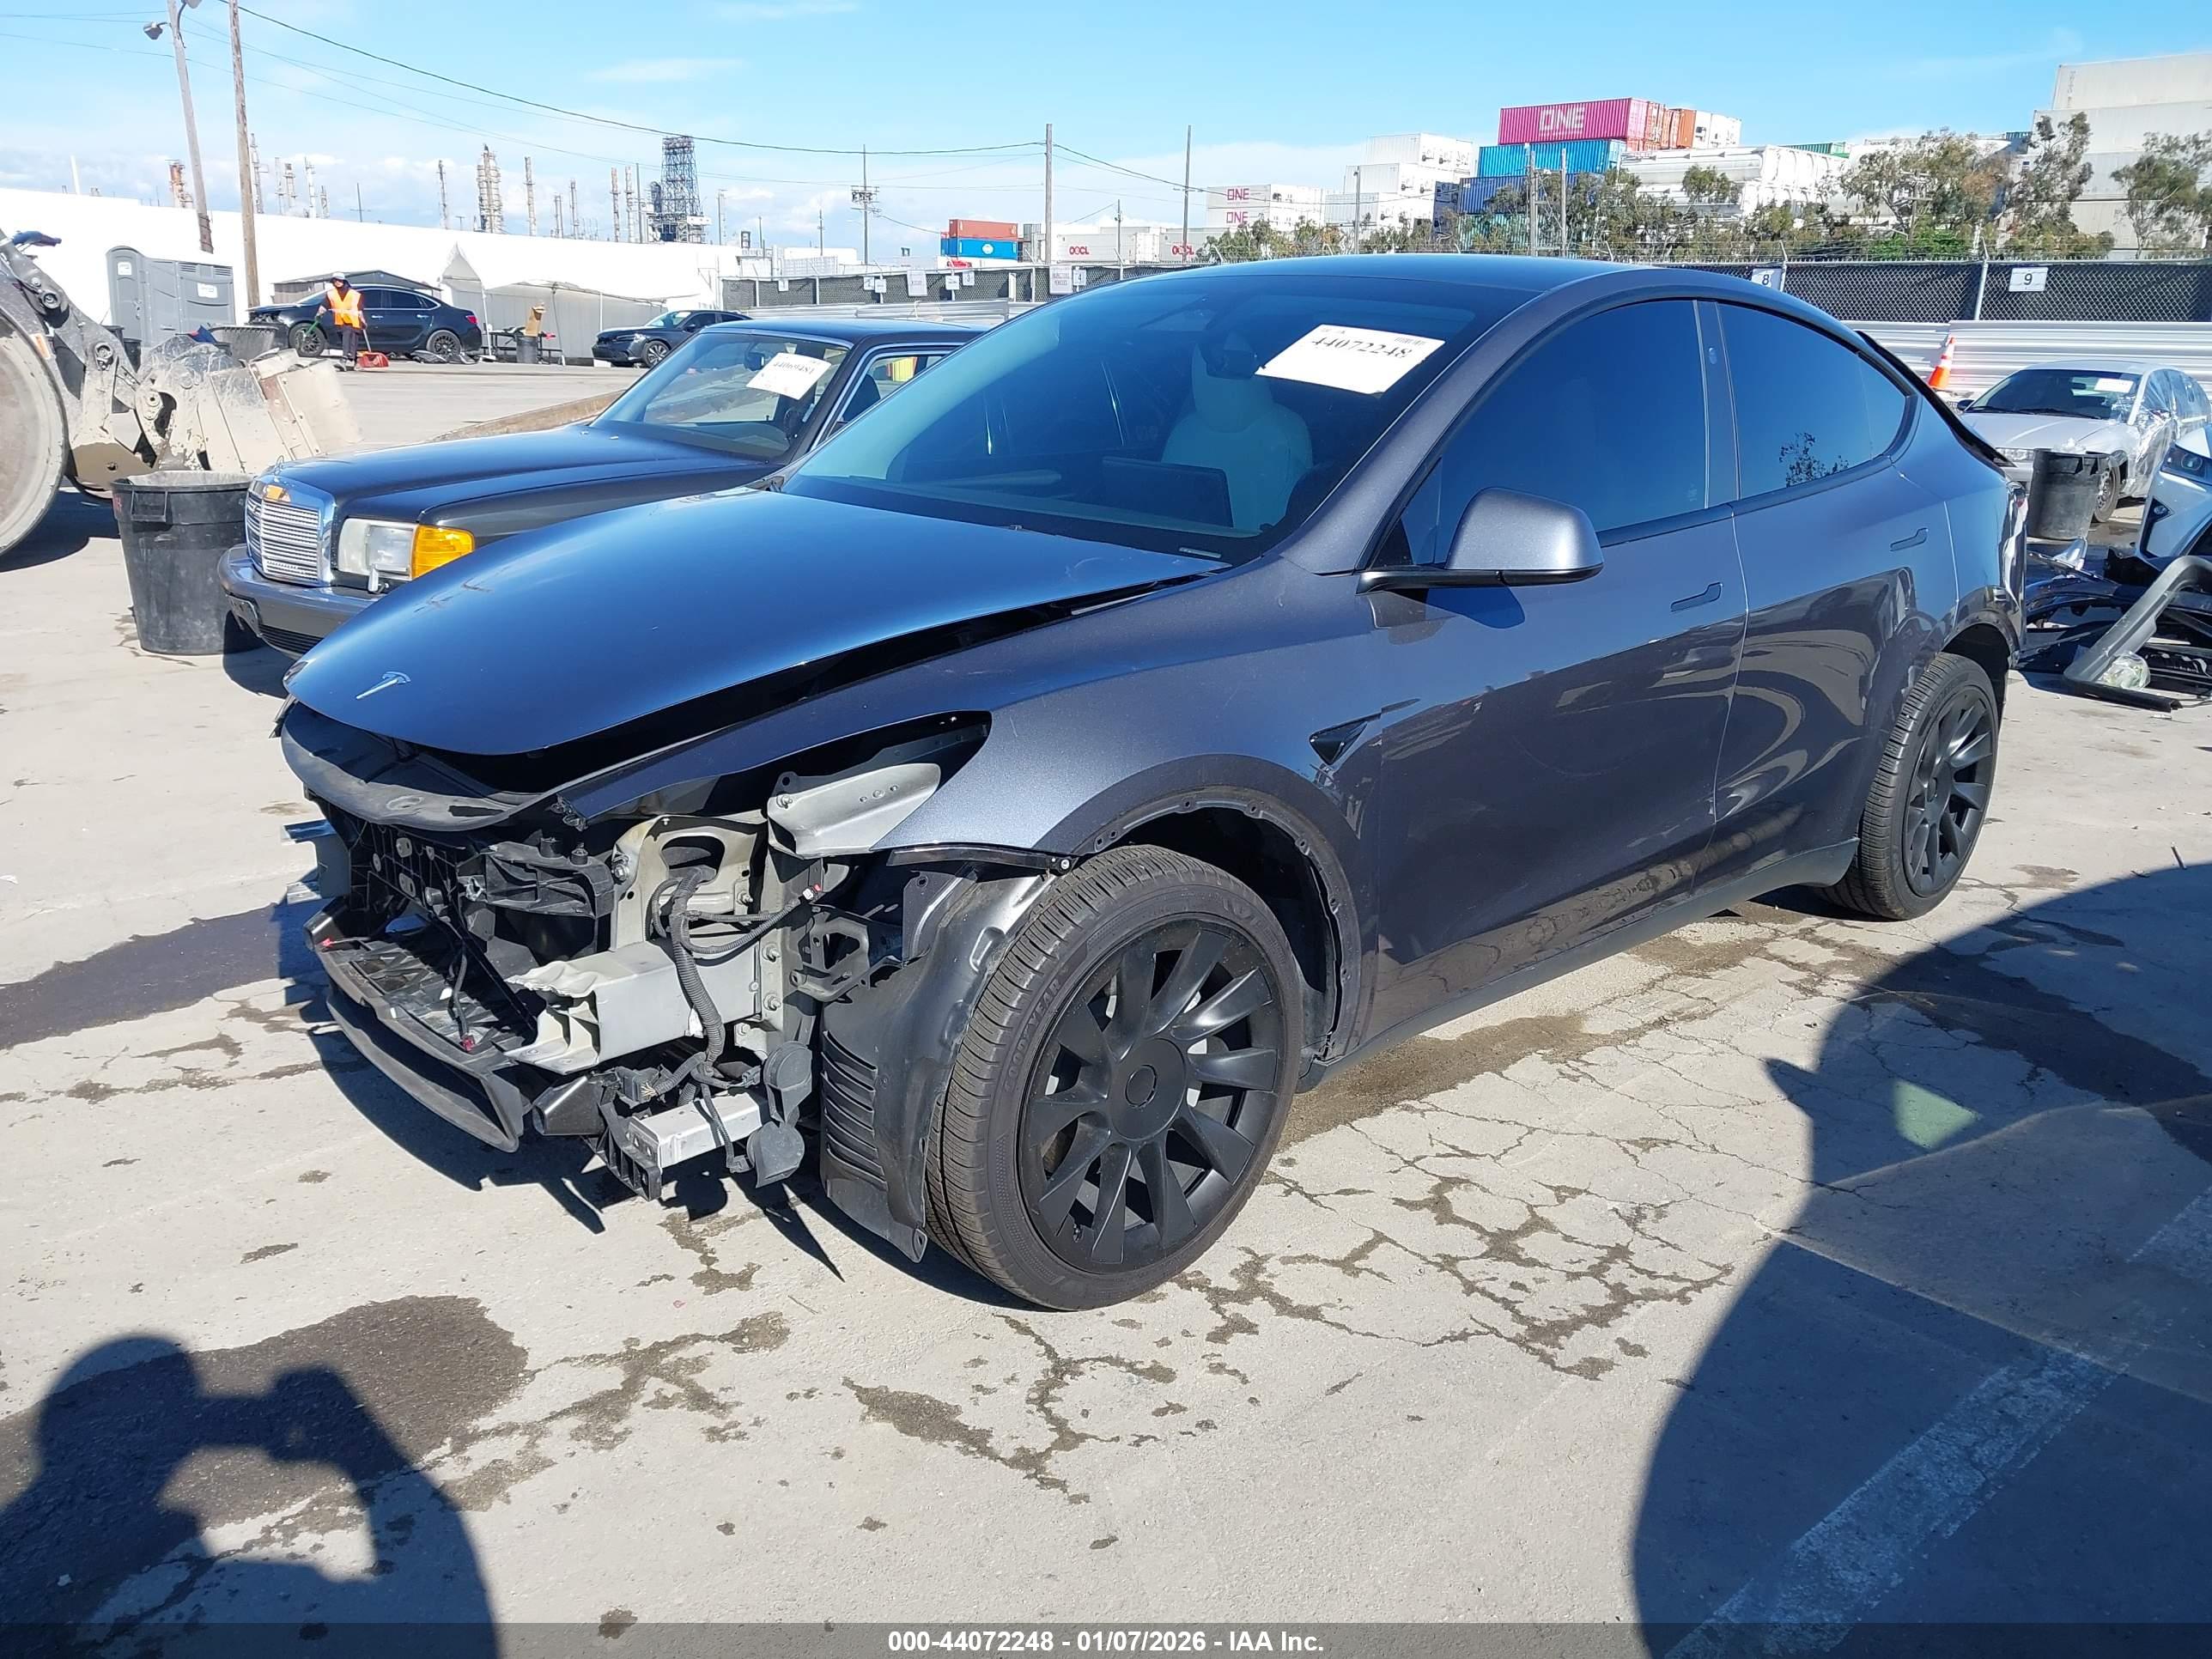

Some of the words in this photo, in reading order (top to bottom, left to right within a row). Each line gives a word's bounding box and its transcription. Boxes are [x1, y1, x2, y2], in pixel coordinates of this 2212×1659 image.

[1539, 106, 1585, 131] ONE
[1227, 187, 1250, 201] ONE
[1225, 210, 1249, 224] ONE
[1069, 246, 1090, 255] OOCL
[1761, 274, 1770, 286] 8
[2024, 273, 2033, 286] 9
[1311, 337, 1413, 358] 44072248
